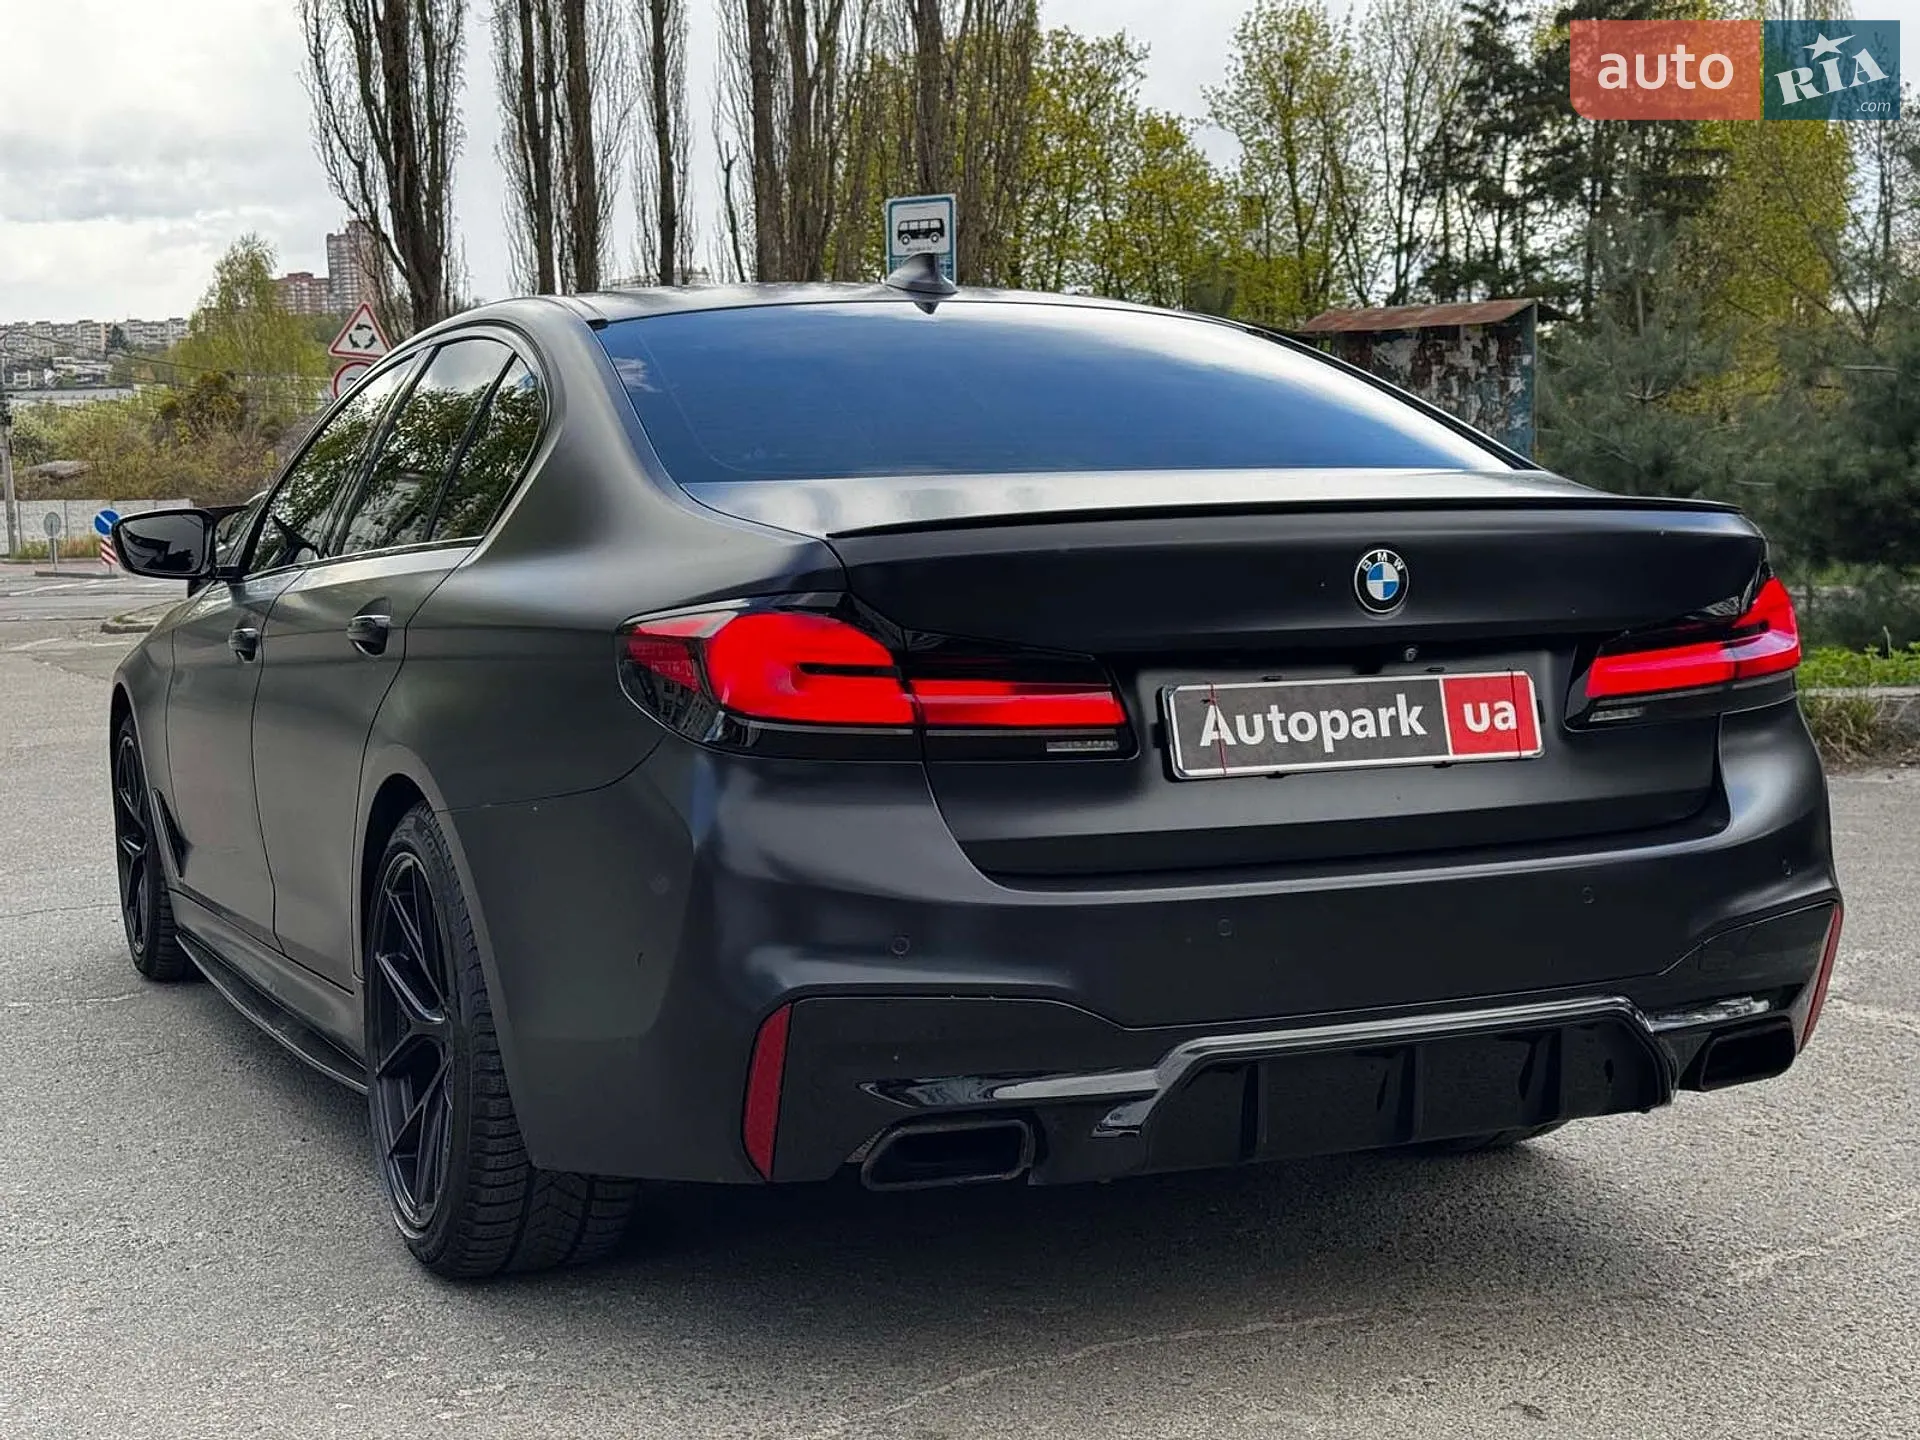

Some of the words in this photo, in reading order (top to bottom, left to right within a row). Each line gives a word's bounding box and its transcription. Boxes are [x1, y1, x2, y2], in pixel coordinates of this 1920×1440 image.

[1361, 552, 1405, 571] BMW
[1199, 693, 1428, 753] Autopark
[1463, 700, 1518, 733] ua
